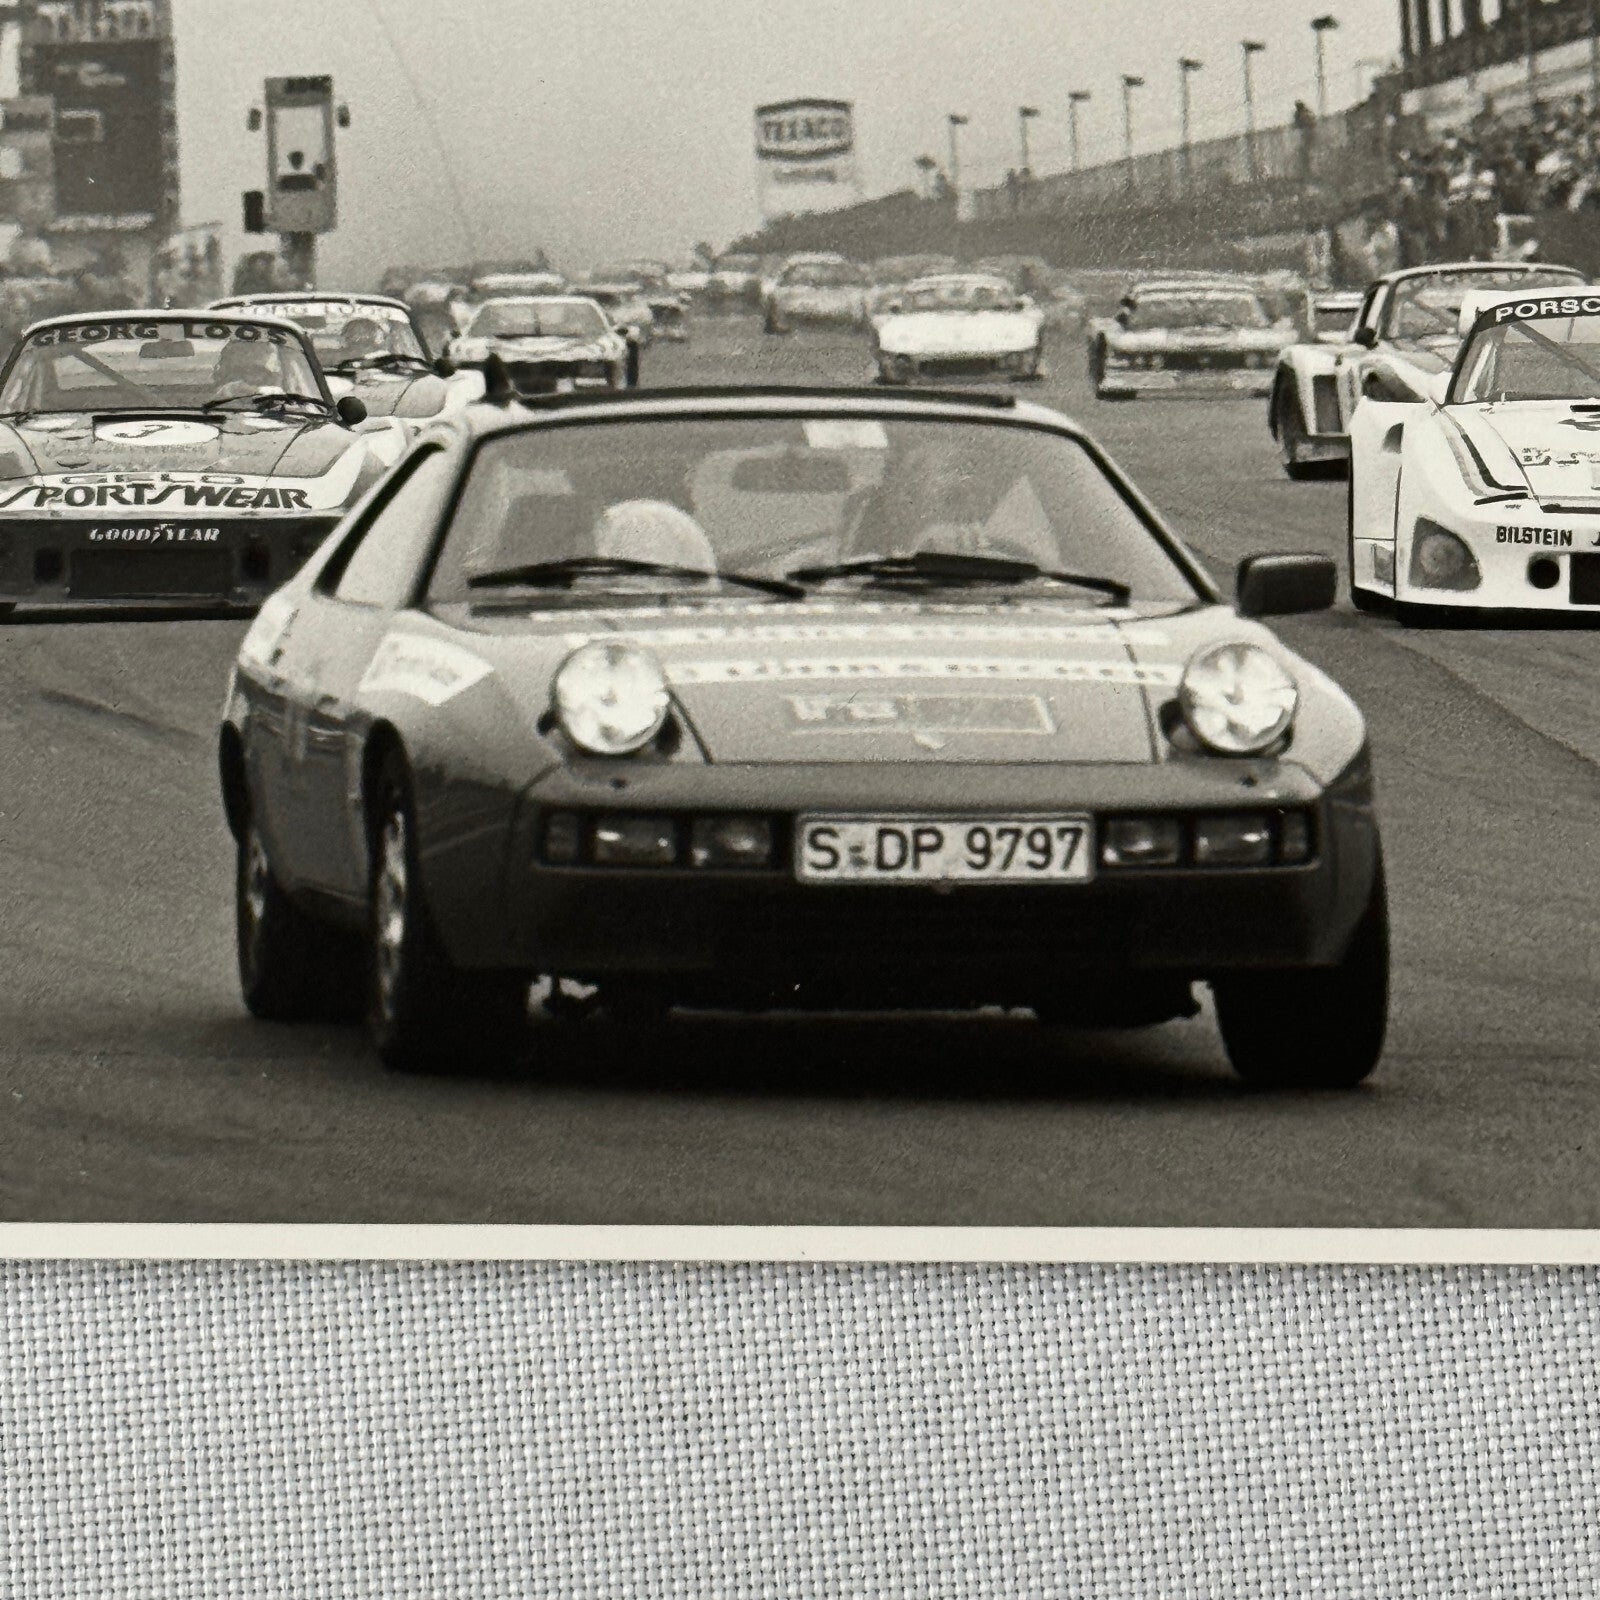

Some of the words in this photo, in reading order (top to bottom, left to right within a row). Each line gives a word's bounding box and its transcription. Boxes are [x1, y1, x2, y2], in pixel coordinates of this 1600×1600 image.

[30, 322, 159, 346] GEORG
[184, 323, 288, 346] LOOS
[0, 483, 313, 509] SPORTSWEAR
[88, 525, 221, 543] GOODYEAR
[1495, 525, 1573, 547] BILSTEIN
[964, 825, 1084, 871] 9797
